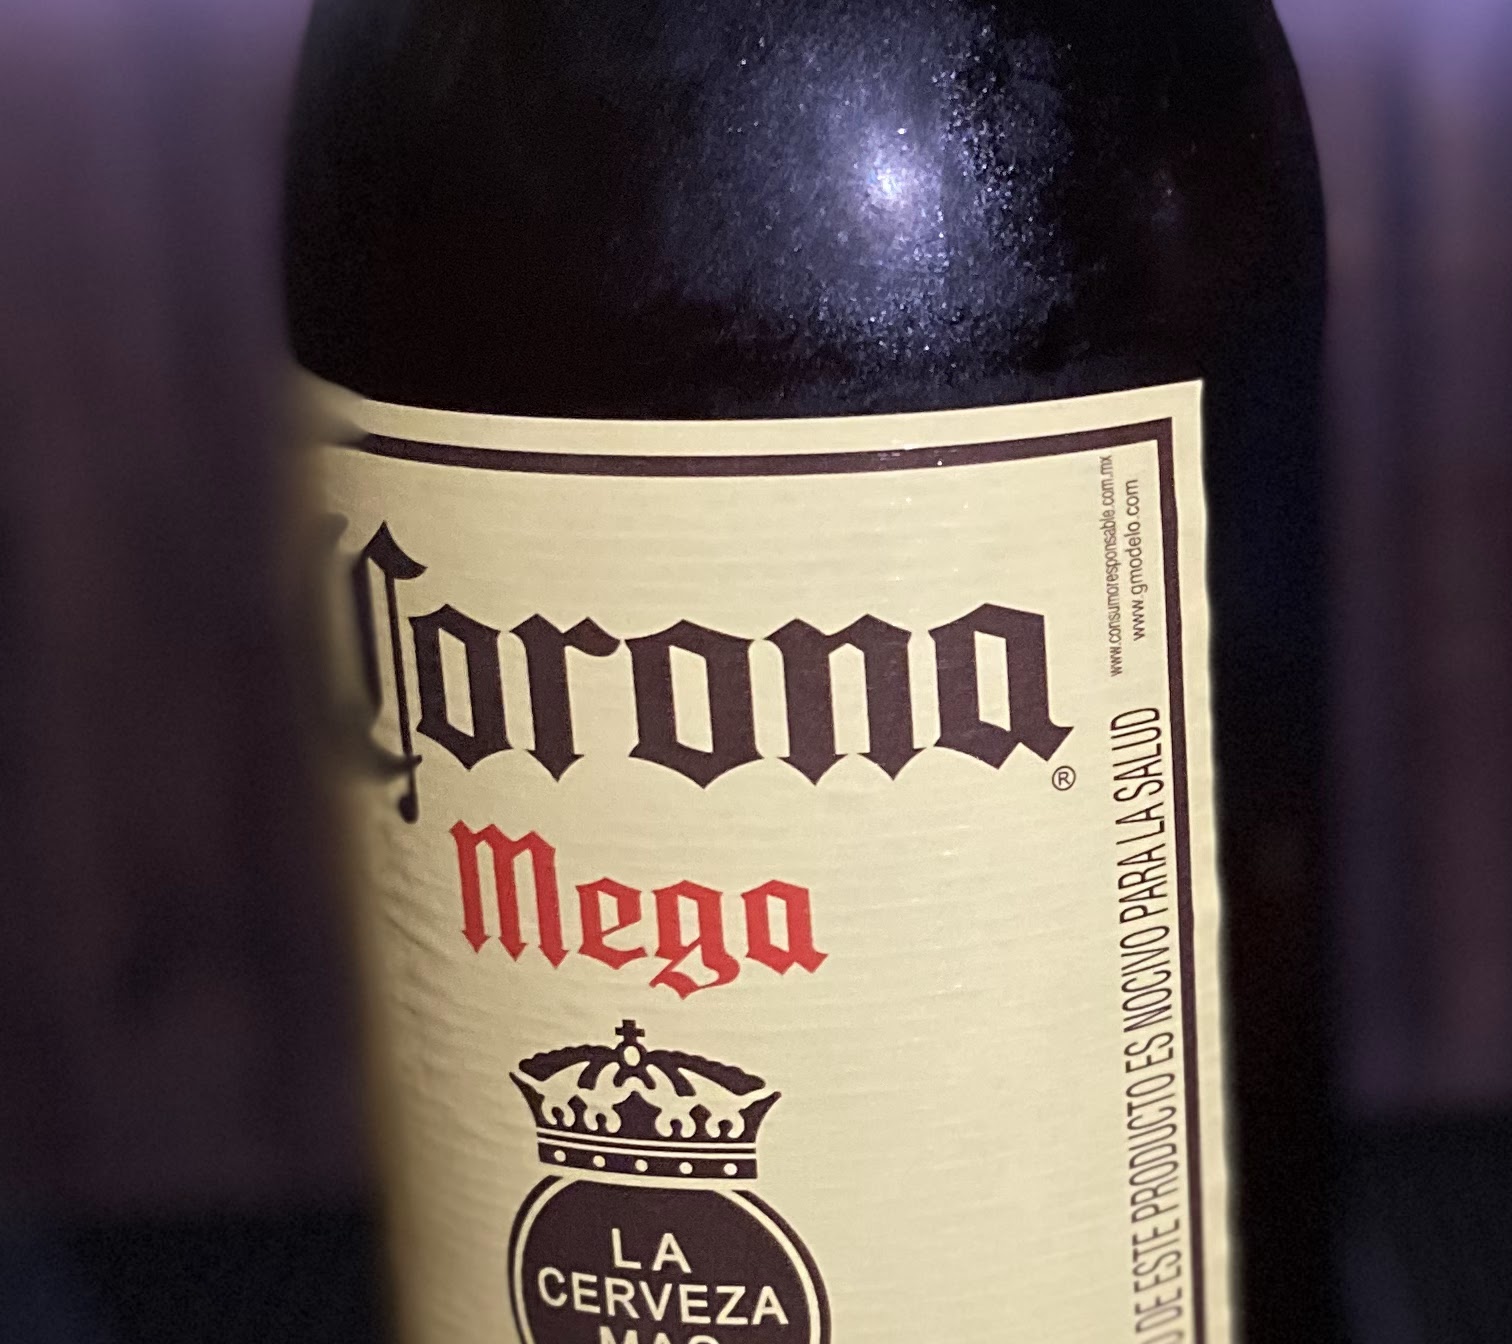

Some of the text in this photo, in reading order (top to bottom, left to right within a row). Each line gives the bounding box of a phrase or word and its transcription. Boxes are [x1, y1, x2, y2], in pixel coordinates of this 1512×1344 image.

[1099, 455, 1123, 677] www.consumoresponsable.com.mx
[1125, 479, 1148, 641] www.gmodelo.com
[342, 520, 1074, 824] Corona
[1110, 707, 1165, 802] SALUD
[1115, 801, 1165, 845] LA
[449, 819, 829, 1001] Mega
[1117, 843, 1168, 924] PARA
[1120, 925, 1173, 1033] NOCIVO
[1124, 1031, 1174, 1074] ES
[1126, 1072, 1180, 1223] PRODUCTO
[611, 1228, 692, 1274] LA
[1132, 1218, 1182, 1294] ESTE
[537, 1266, 789, 1326] CERVEZA
[1135, 1287, 1183, 1333] DE
